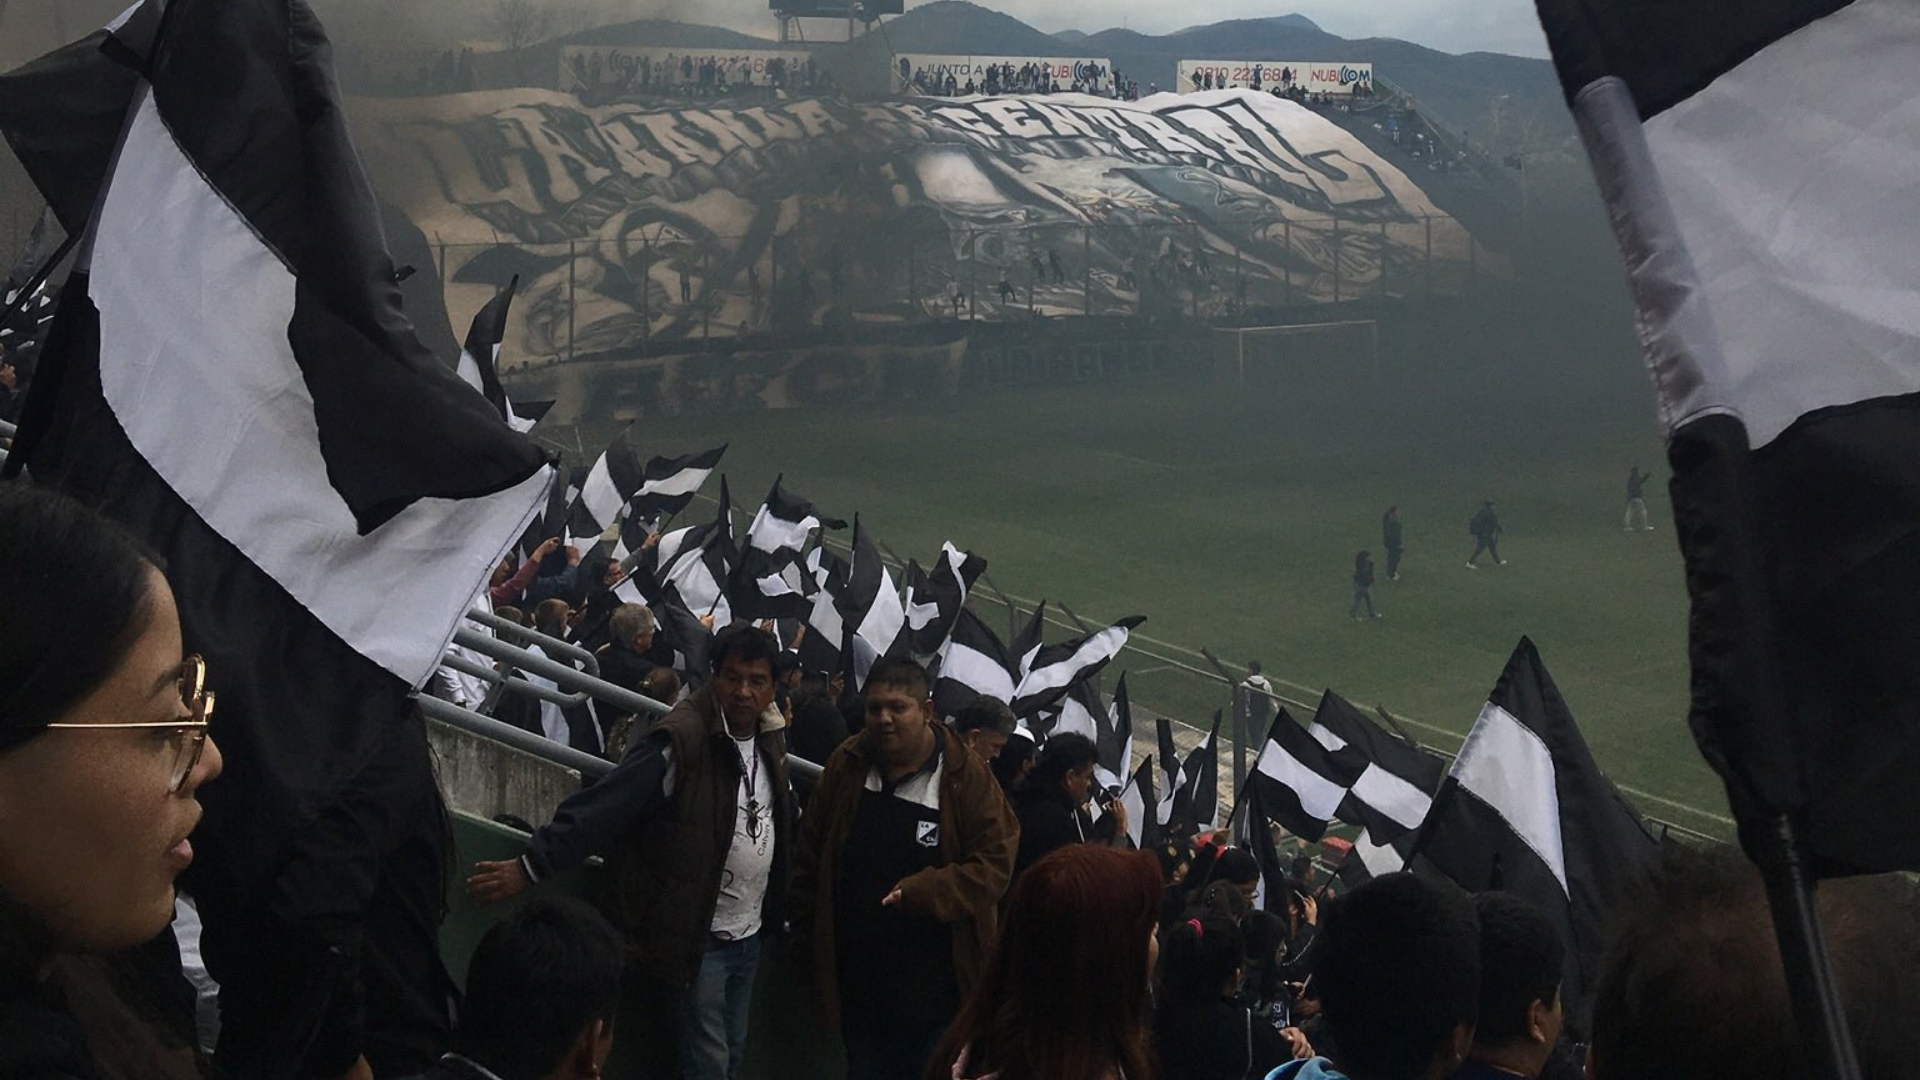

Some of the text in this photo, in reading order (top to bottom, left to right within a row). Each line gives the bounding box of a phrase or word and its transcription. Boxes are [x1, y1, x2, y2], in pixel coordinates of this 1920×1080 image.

[926, 64, 970, 75] JUNTO
[974, 64, 984, 76] A
[1042, 60, 1107, 83] UBICOM
[1263, 67, 1298, 81] 684
[932, 98, 1387, 206] CENTRAL
